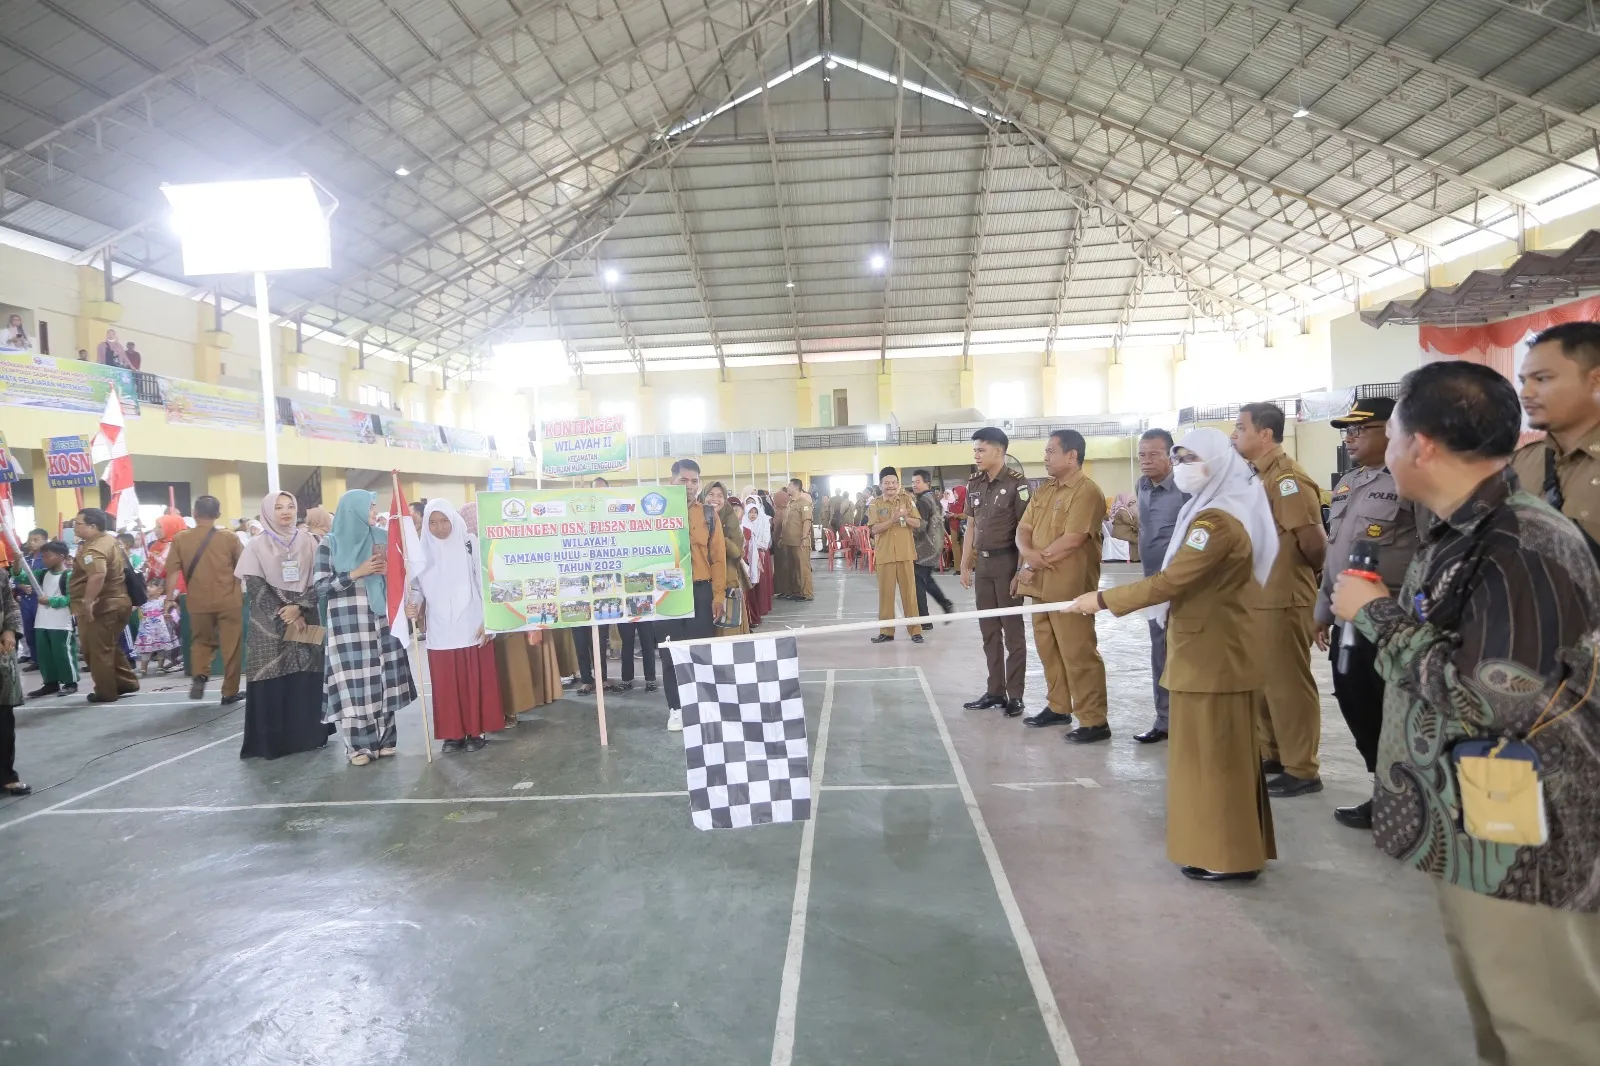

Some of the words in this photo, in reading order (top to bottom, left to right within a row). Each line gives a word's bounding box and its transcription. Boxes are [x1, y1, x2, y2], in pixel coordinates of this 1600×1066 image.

[18, 376, 56, 388] PELAJARAN
[545, 416, 623, 438] KONTINGEN
[555, 438, 600, 452] WILAYAH
[603, 436, 612, 448] II
[47, 452, 91, 476] KOSN
[567, 453, 598, 463] KECAMATAN
[83, 476, 94, 484] IV
[1368, 492, 1398, 502] POLRI
[486, 523, 558, 539] KONTINGEN
[590, 520, 627, 534] FLS2N
[629, 519, 652, 532] DAN
[562, 536, 608, 548] WILAYAH
[610, 536, 616, 546] I
[504, 551, 551, 564] TAMIANG
[554, 551, 581, 562] HULU
[589, 548, 629, 560] BANDAR
[632, 545, 671, 556] PUSAKA
[558, 562, 592, 574] TAHUN
[594, 560, 622, 571] 2023
